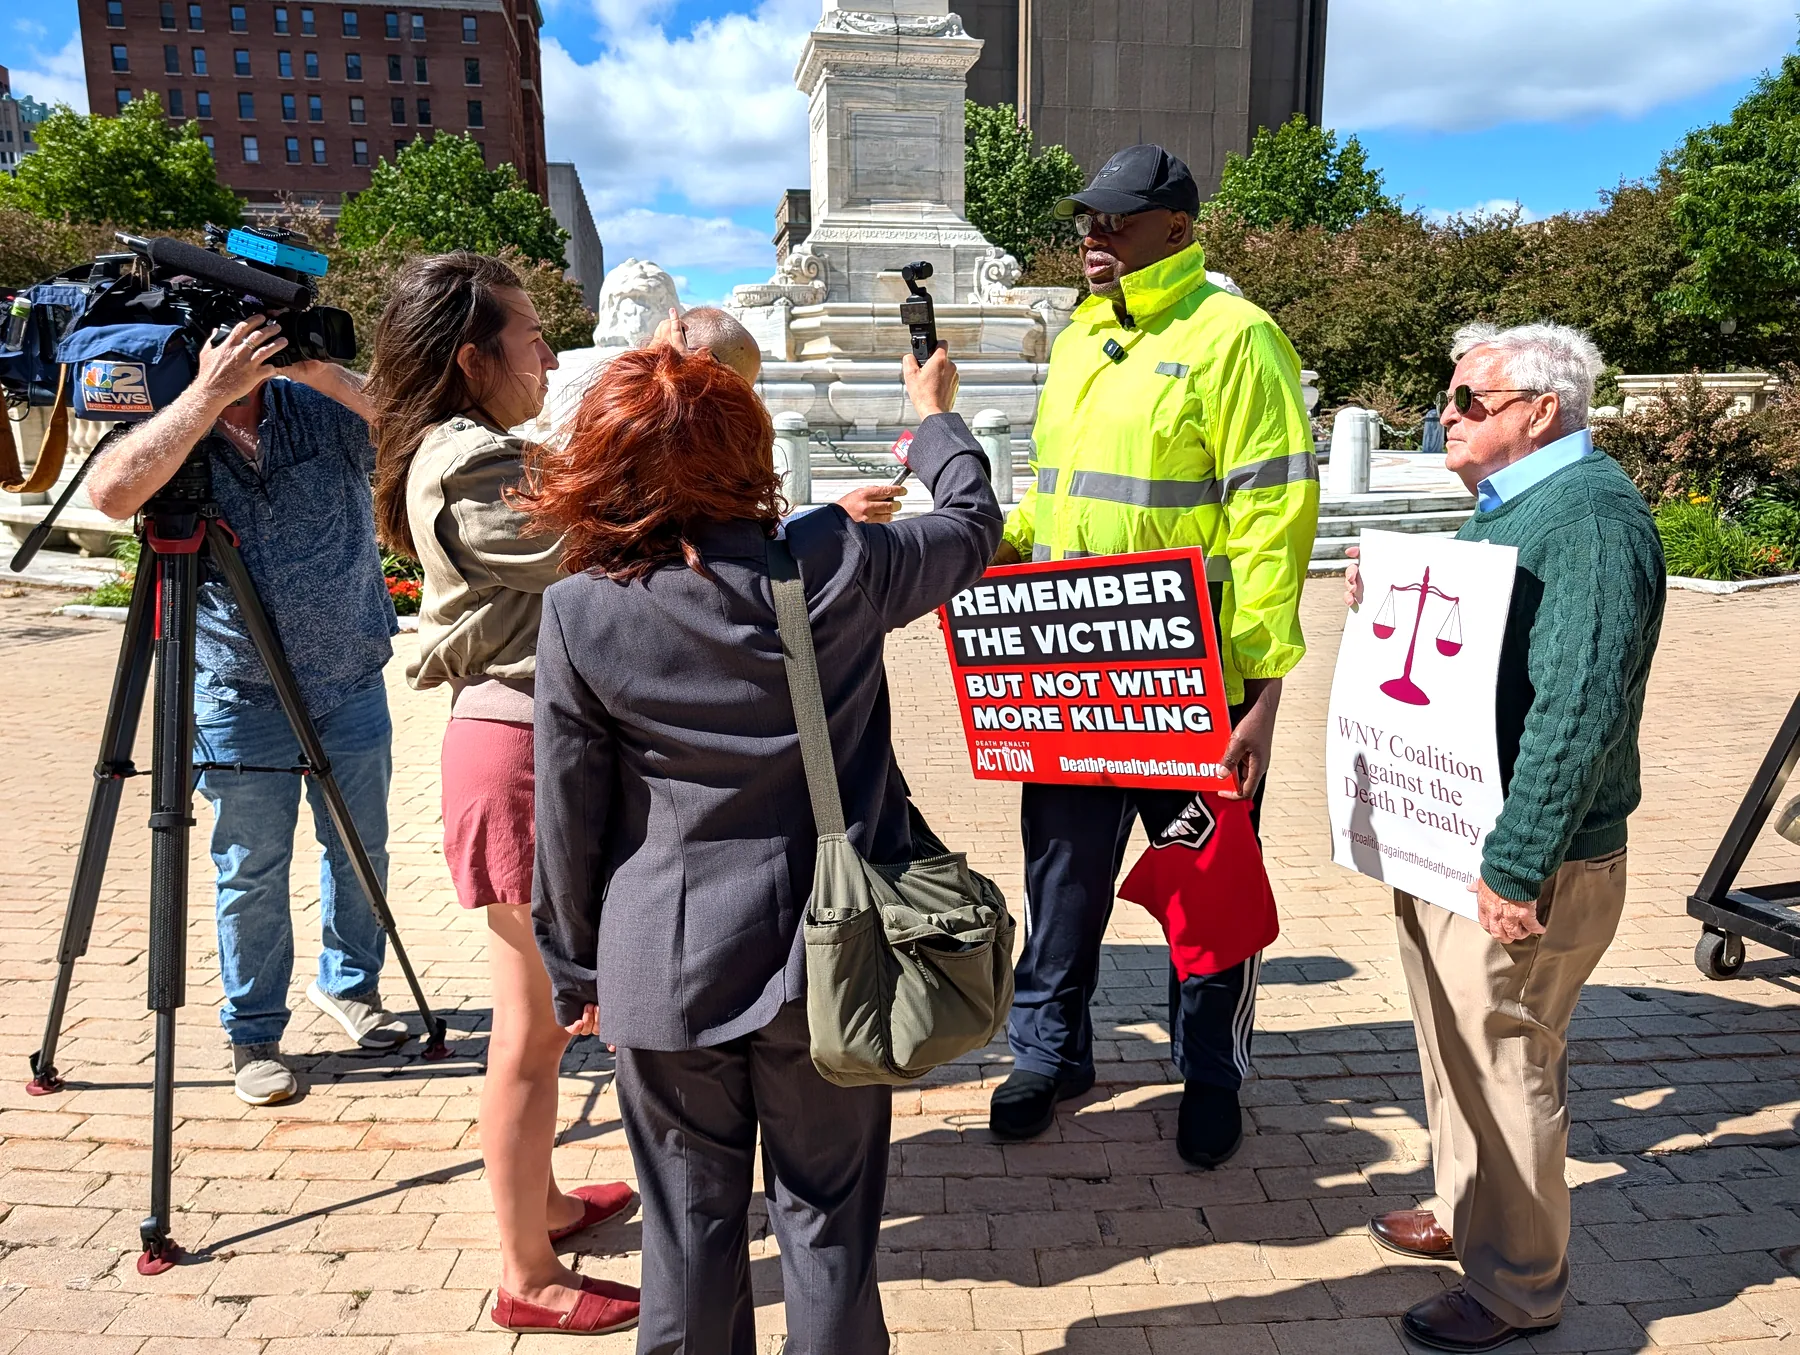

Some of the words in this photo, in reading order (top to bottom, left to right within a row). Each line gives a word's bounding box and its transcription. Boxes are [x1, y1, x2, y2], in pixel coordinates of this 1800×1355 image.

[110, 366, 145, 392] 2
[85, 391, 148, 404] NEWS
[951, 570, 1186, 617] REMEMBER
[957, 626, 1025, 658] THE
[1030, 616, 1196, 655] VICTIMS
[965, 673, 1024, 699] BUT
[1030, 671, 1102, 699] NOT
[1108, 668, 1206, 698] WITH
[972, 705, 1064, 732] MORE
[1069, 705, 1213, 733] KILLING
[976, 746, 1035, 773] ACTION
[999, 740, 1031, 748] PENALTY
[1338, 715, 1384, 752] WNY
[1389, 734, 1485, 784] Coalition
[1353, 752, 1424, 795] Against
[1430, 779, 1463, 806] the
[1344, 776, 1397, 815] Death
[1402, 796, 1482, 846] Penalty
